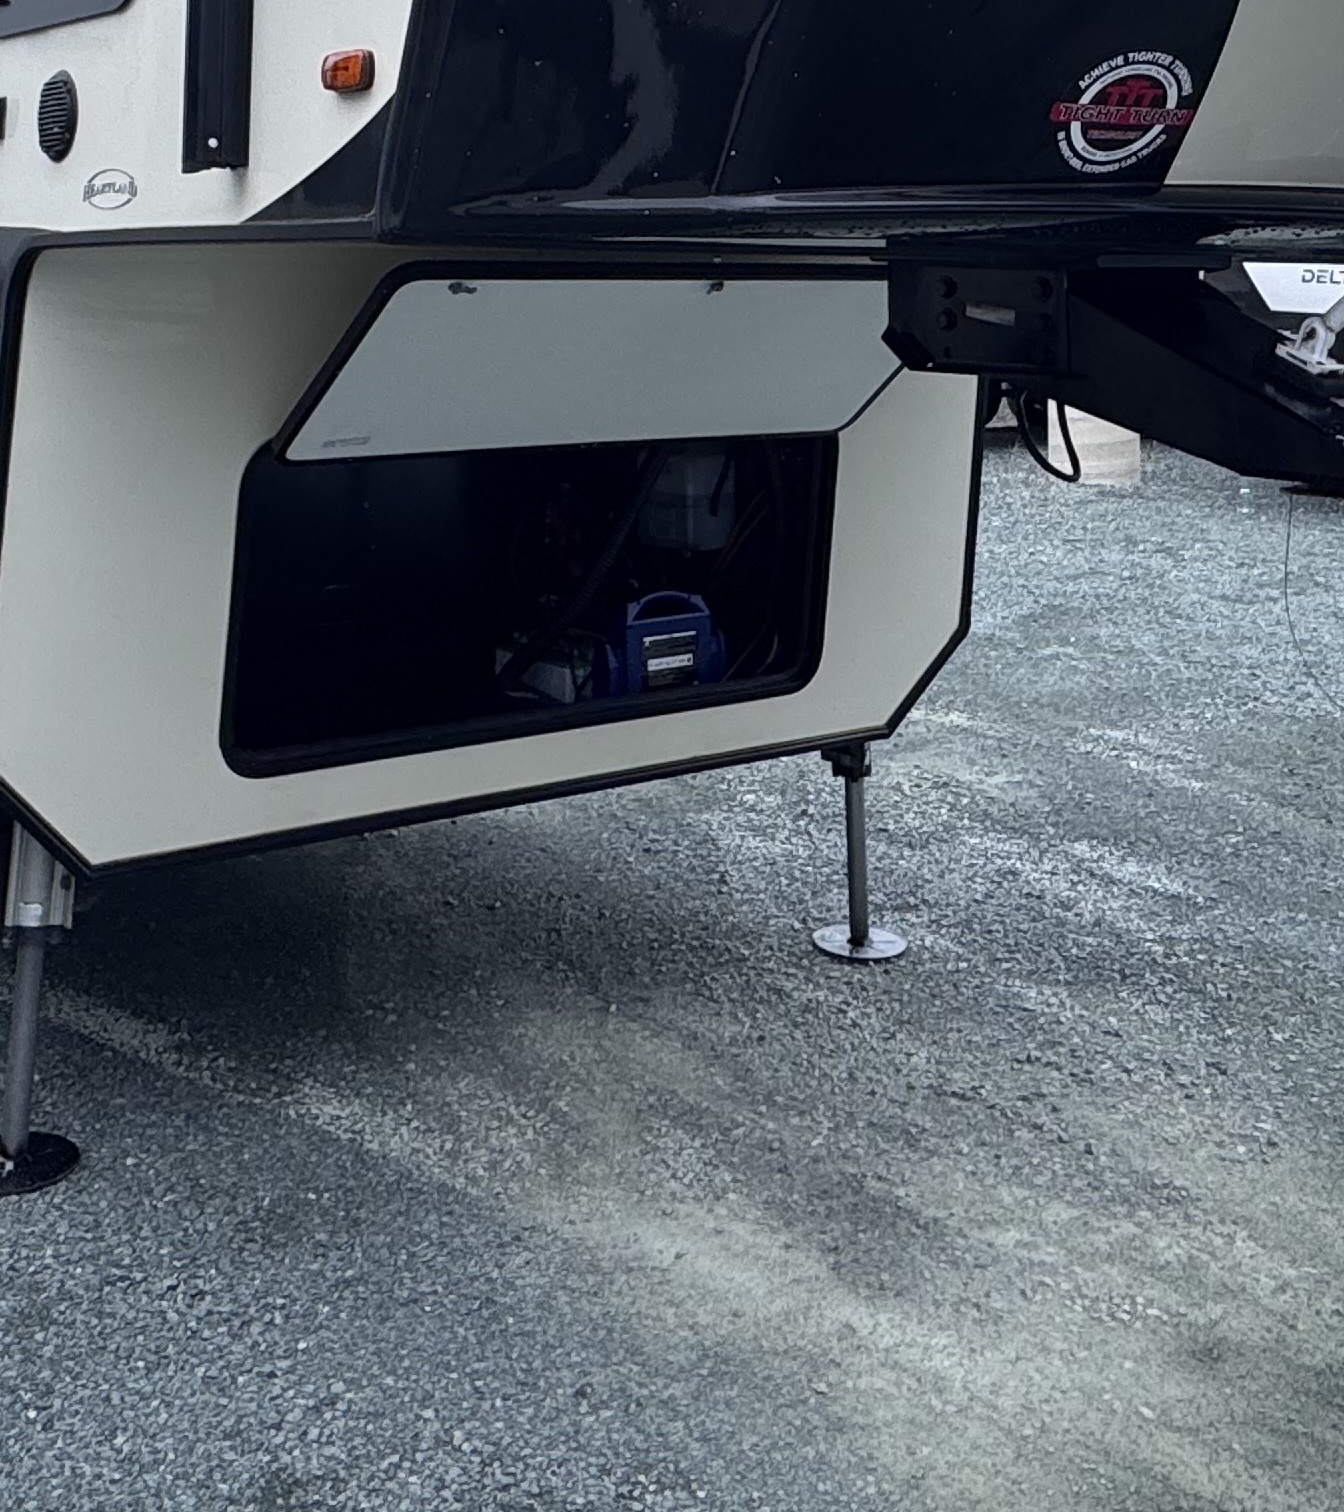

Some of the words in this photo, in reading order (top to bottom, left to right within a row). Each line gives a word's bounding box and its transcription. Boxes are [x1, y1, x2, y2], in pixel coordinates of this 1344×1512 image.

[1078, 54, 1125, 90] ACHIEVE
[1127, 51, 1174, 67] TIGHTER
[1059, 103, 1125, 122] TIGHT
[1130, 107, 1186, 124] TURN
